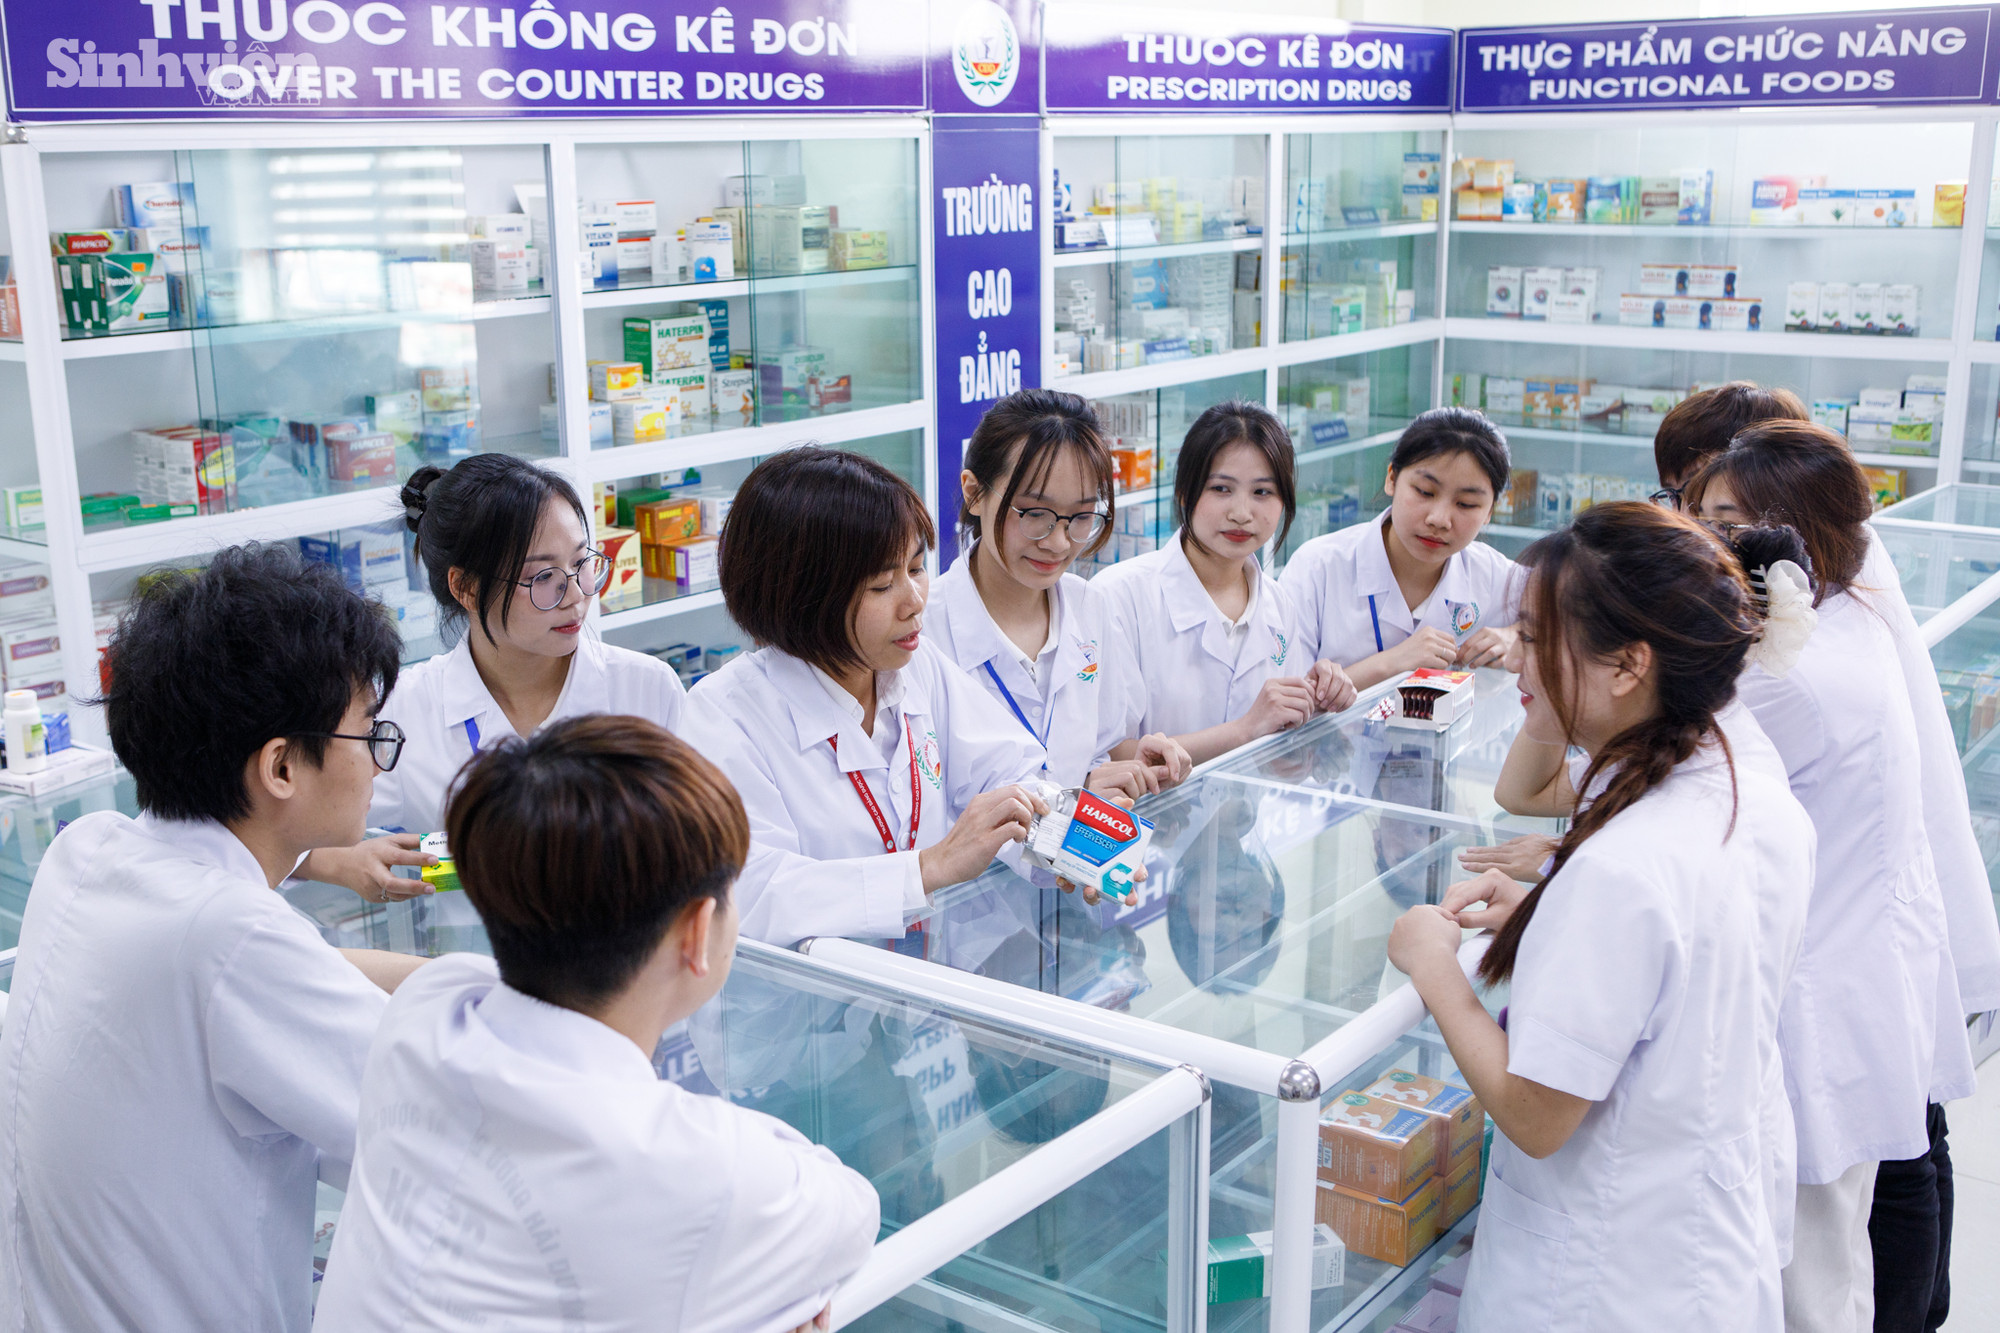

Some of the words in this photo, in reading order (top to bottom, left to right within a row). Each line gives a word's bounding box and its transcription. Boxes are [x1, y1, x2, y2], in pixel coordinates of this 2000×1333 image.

[431, 0, 657, 52] KHÔNG
[676, 7, 735, 55] KÊ
[750, 17, 857, 57] ĐƠN
[1278, 34, 1319, 69] KÊ
[1329, 39, 1404, 71] ĐƠN
[1479, 40, 1572, 77] THỰC
[1584, 26, 1692, 69] PHẨM
[1704, 28, 1825, 62] CHỨC
[1838, 24, 1967, 59] NĂNG
[207, 64, 357, 100] OVER
[372, 67, 462, 99] THE
[477, 68, 684, 101] COUNTER
[697, 72, 825, 101] DRUGS
[1107, 76, 1320, 101] PRESCRIPTION
[1327, 79, 1413, 101] DRUGS
[1529, 74, 1751, 101] FUNCTIONAL
[1762, 70, 1896, 94] FOODS
[942, 173, 1033, 237] TRƯỜNG
[967, 267, 1013, 319] CAO
[657, 324, 704, 339] HATERPIN
[959, 330, 1022, 403] ĐẲNG
[1073, 824, 1118, 852] EFFERVESCENT
[1081, 803, 1135, 838] HAPACOL
